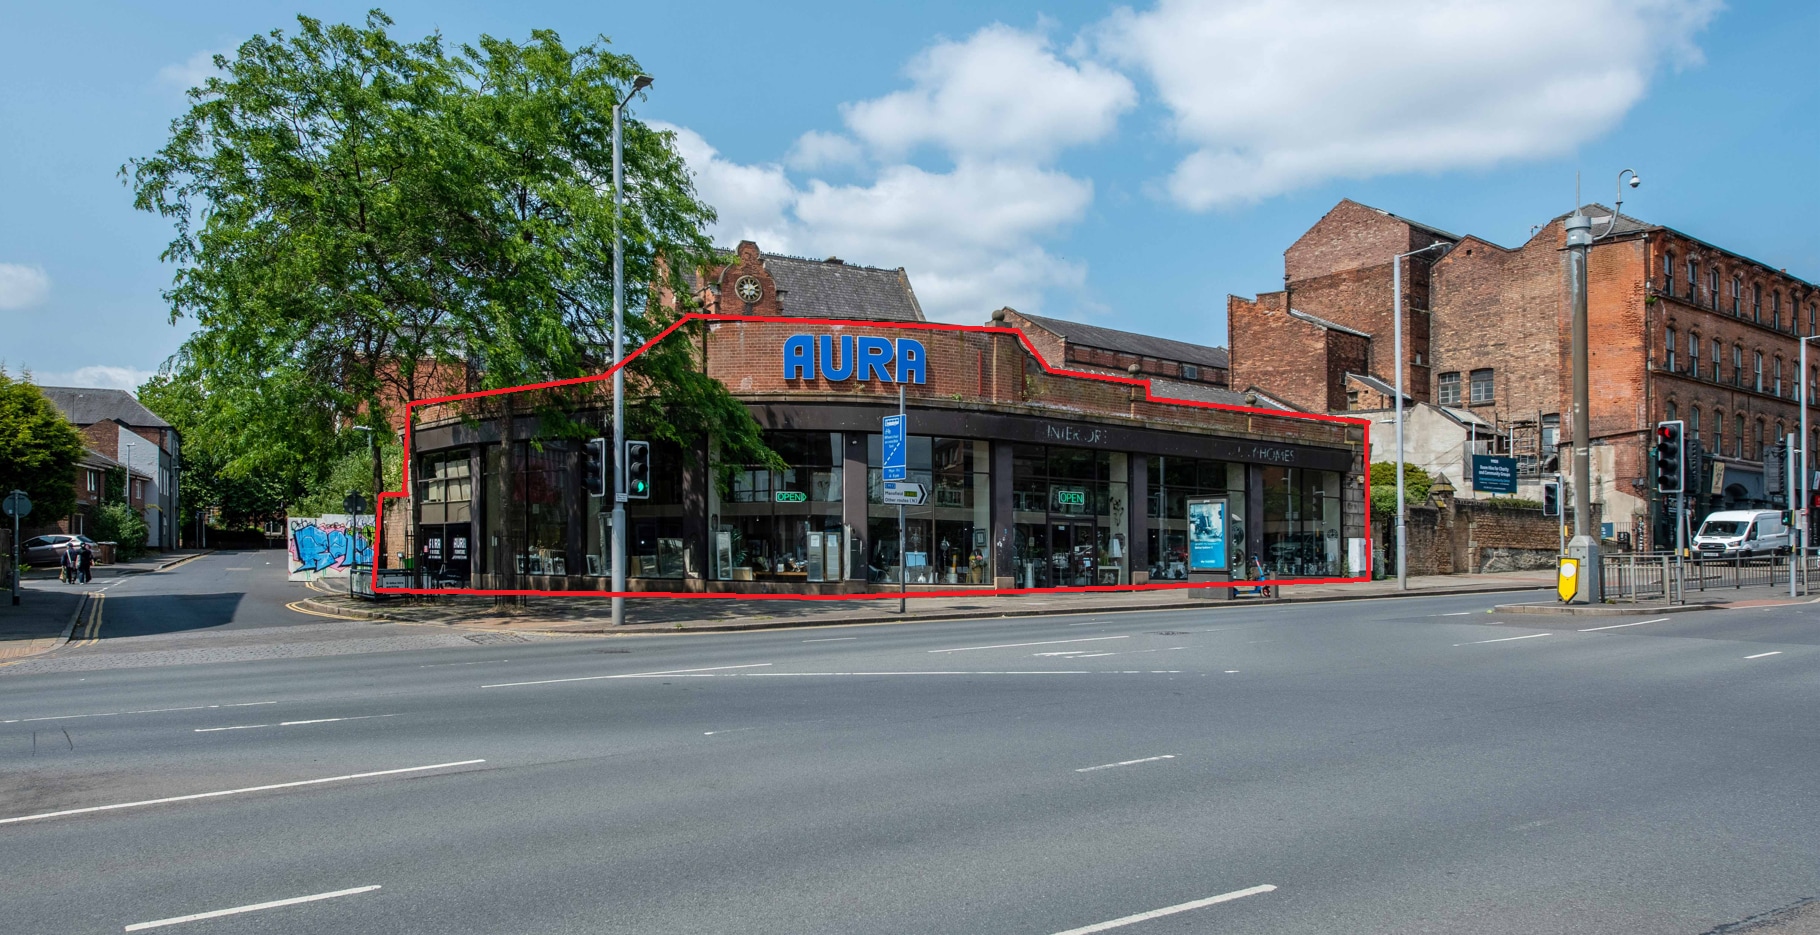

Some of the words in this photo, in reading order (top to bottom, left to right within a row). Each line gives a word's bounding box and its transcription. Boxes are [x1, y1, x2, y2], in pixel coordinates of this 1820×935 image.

[783, 333, 926, 384] AURA
[1259, 447, 1295, 462] HOMES
[777, 492, 801, 501] OPEN
[1060, 492, 1083, 503] OPEN
